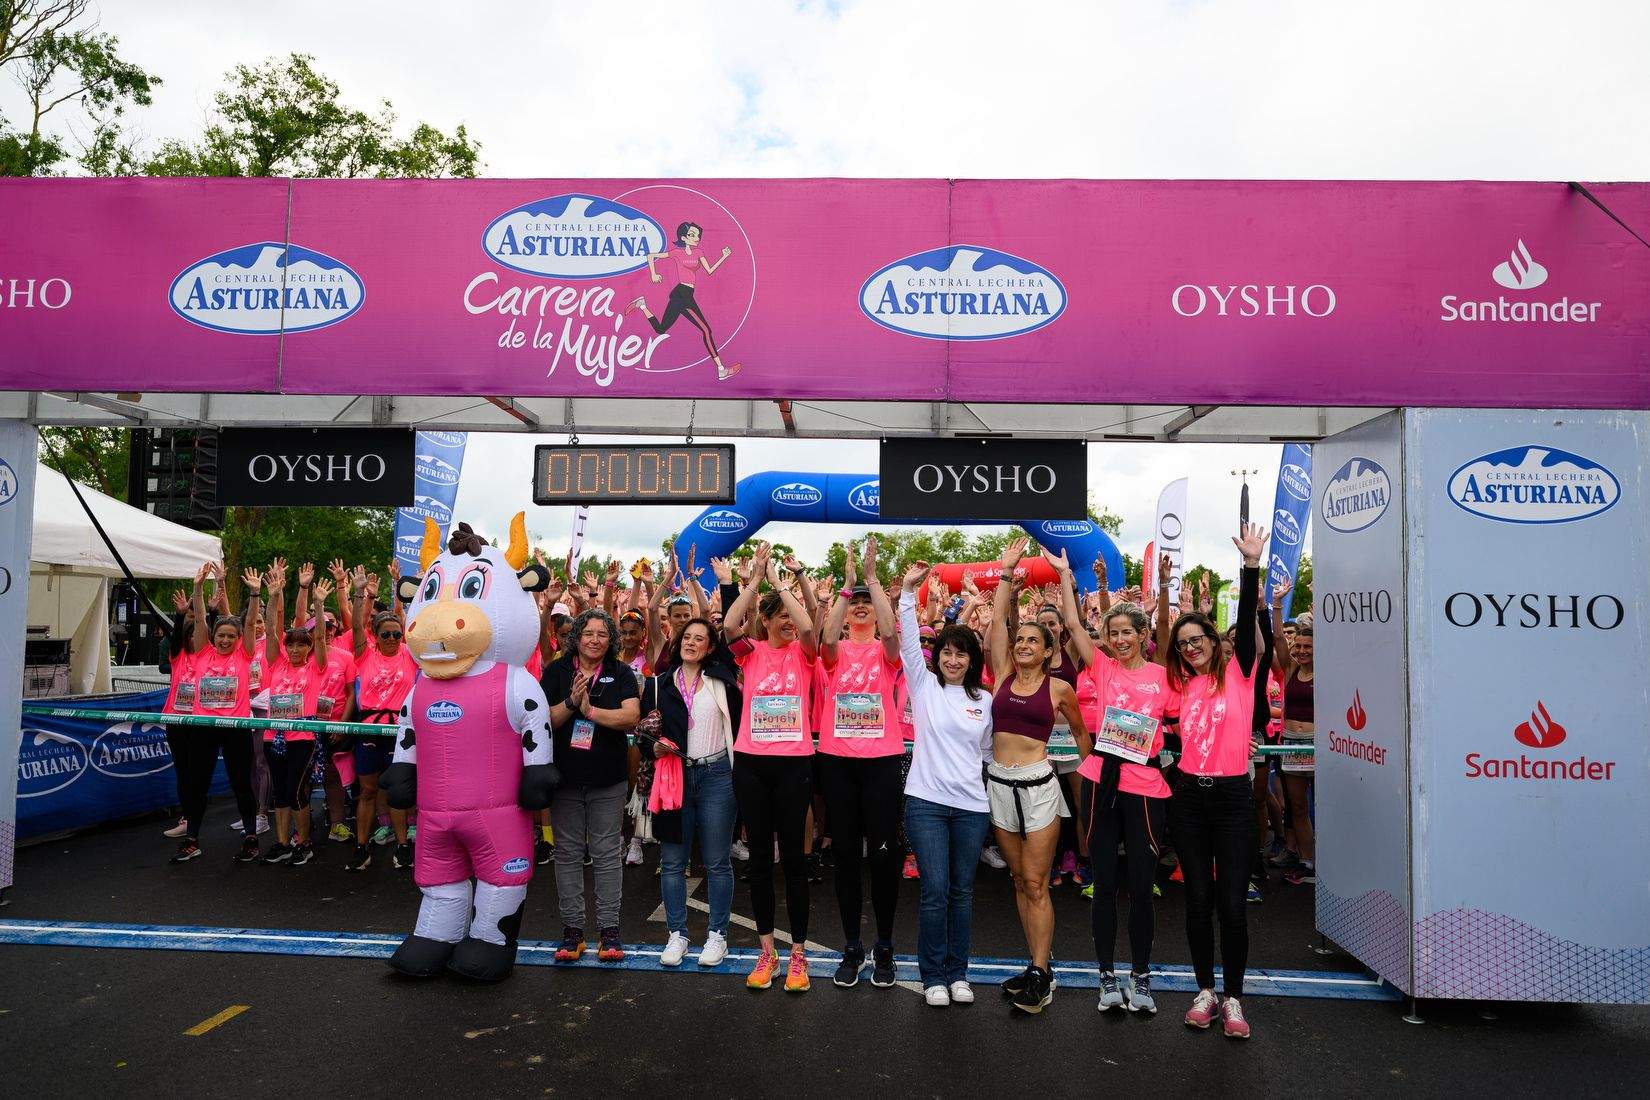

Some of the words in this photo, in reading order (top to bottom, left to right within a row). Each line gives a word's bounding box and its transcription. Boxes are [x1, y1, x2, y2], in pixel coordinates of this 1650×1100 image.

[496, 225, 650, 257] ASTURIANA
[526, 223, 583, 232] CENTRAL
[589, 223, 647, 232] LECHERA
[0, 278, 72, 309] HO
[183, 277, 350, 311] ASTURIANA
[214, 274, 275, 284] CENTRAL
[907, 278, 972, 288] CENTRAL
[979, 278, 1045, 288] LECHERA
[464, 272, 616, 318] Carrera
[875, 280, 1051, 316] ASTURIANA
[1171, 284, 1337, 317] OYSHO
[1440, 295, 1602, 323] Santander
[498, 319, 527, 349] de
[532, 319, 553, 349] la
[547, 314, 671, 387] Mujer
[248, 454, 386, 483] OYSHO
[913, 464, 1057, 494] OYSHO
[1487, 472, 1542, 482] CENTRAL
[1545, 472, 1602, 482] LECHERA
[776, 491, 818, 501] ASTURIANA
[1326, 488, 1387, 519] ASTURIANA
[1460, 474, 1608, 505] ASTURIANA
[702, 518, 745, 529] ASTURIANA
[1323, 590, 1392, 624] OYSHO
[1445, 592, 1625, 630] OYSHO
[1329, 731, 1387, 766] Santander
[1465, 753, 1617, 780] Santander
